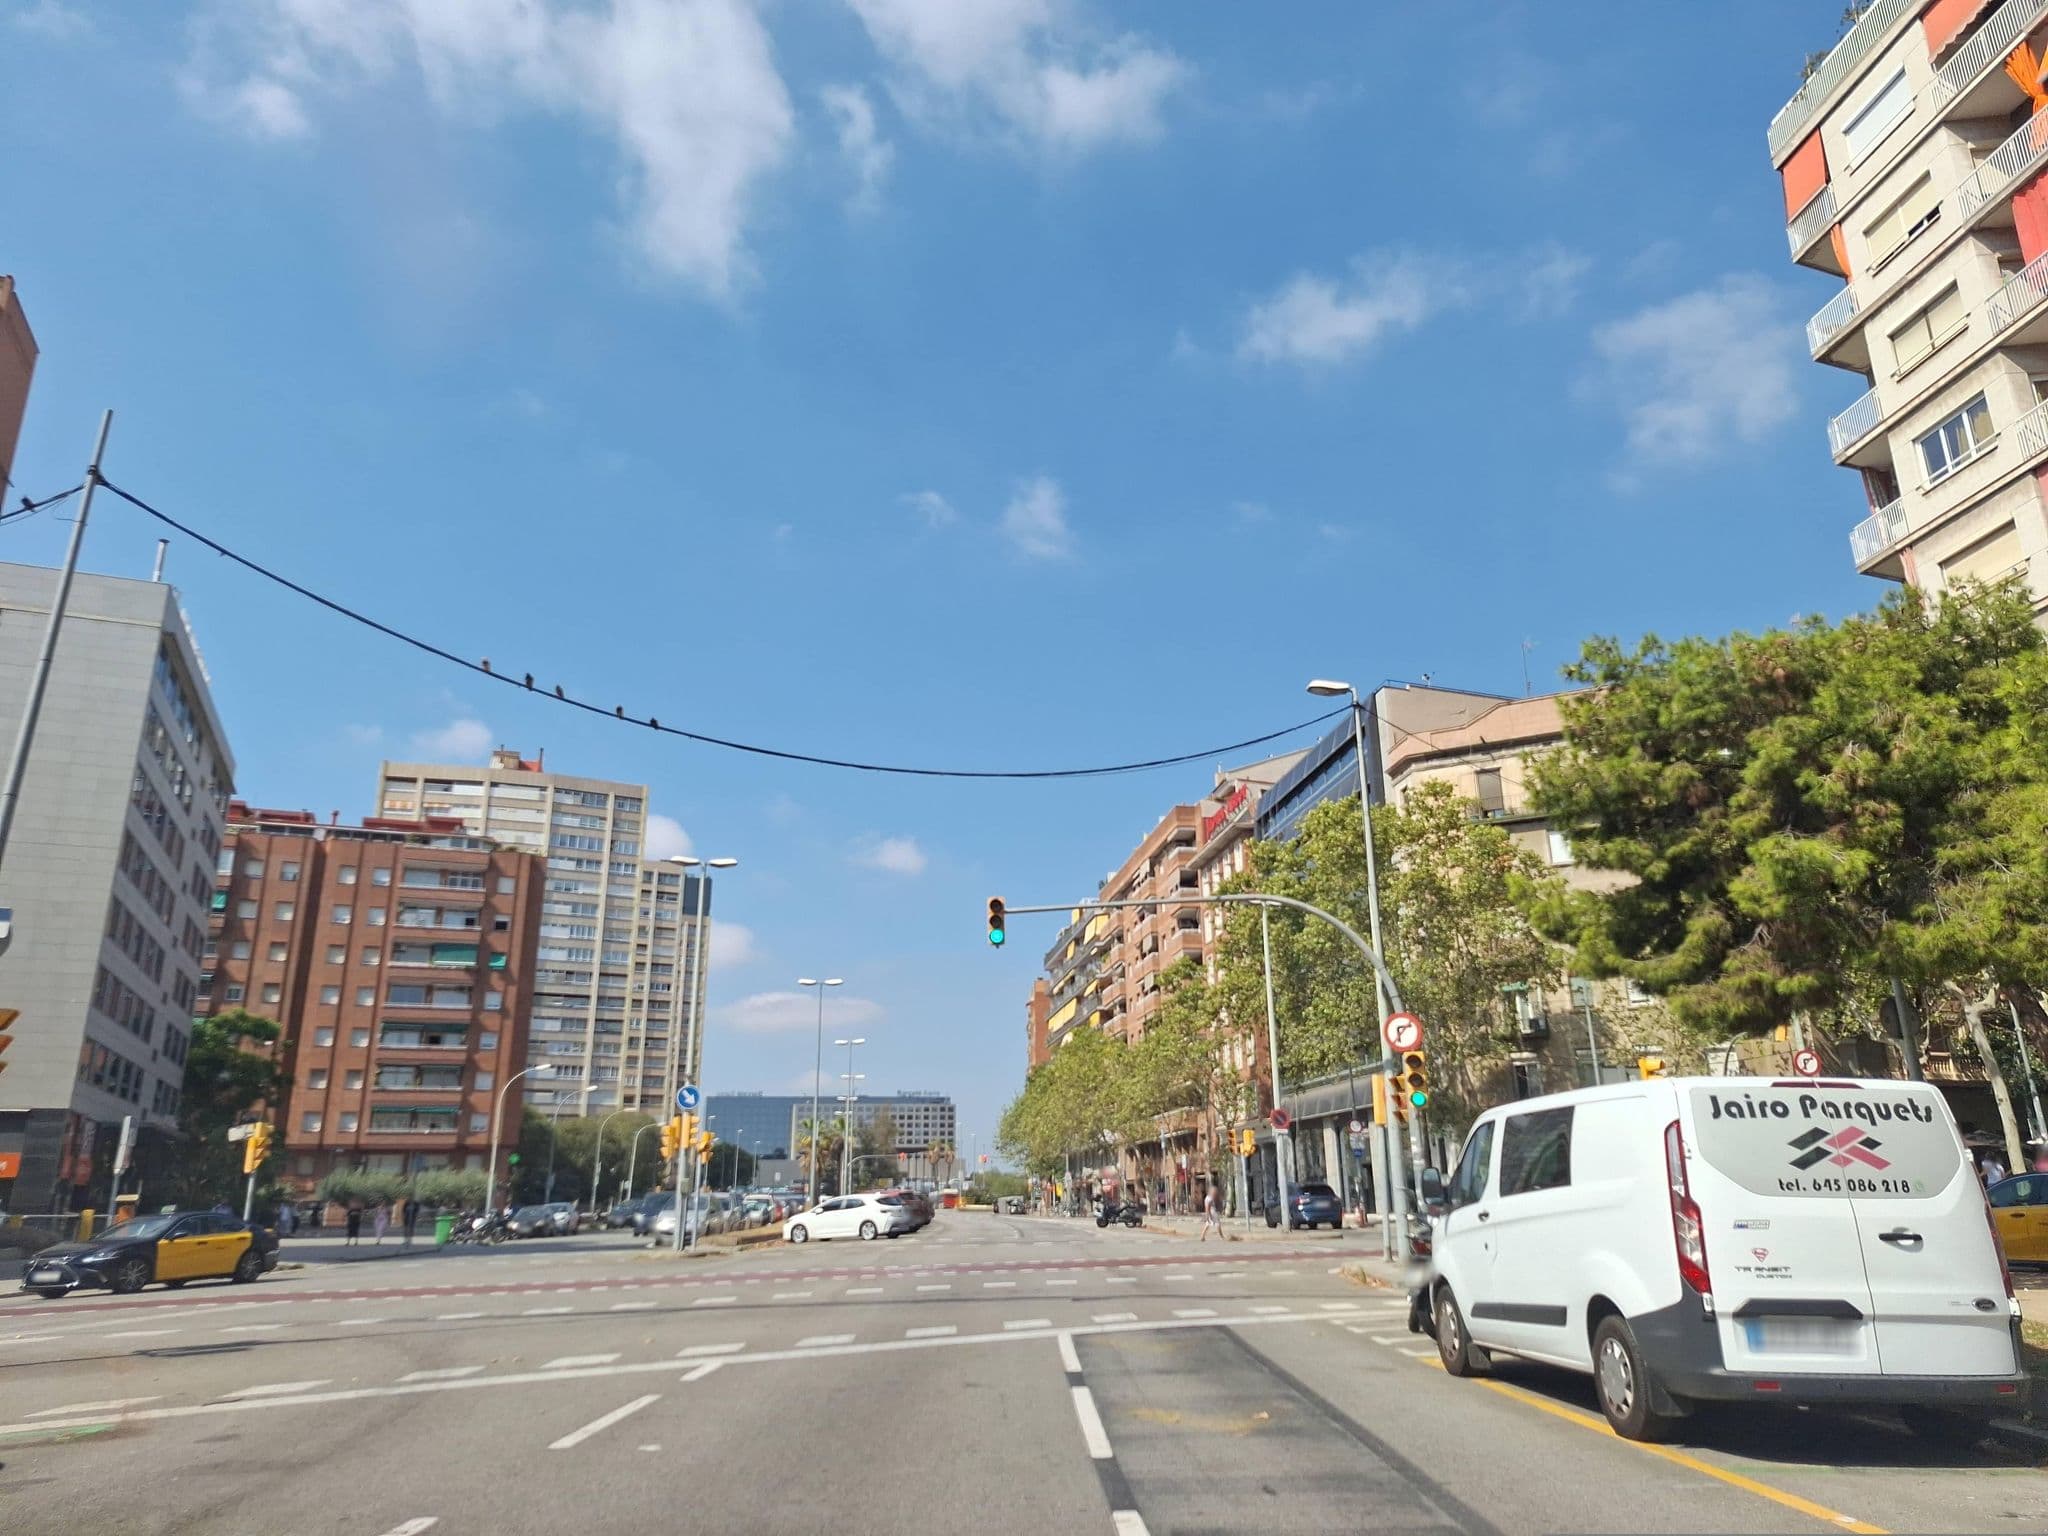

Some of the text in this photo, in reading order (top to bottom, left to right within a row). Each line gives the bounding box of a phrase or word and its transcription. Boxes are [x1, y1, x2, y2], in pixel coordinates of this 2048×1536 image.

[1709, 1093, 1933, 1126] Jairo Parquets
[1778, 1178, 1910, 1194] tel. 645 086 218
